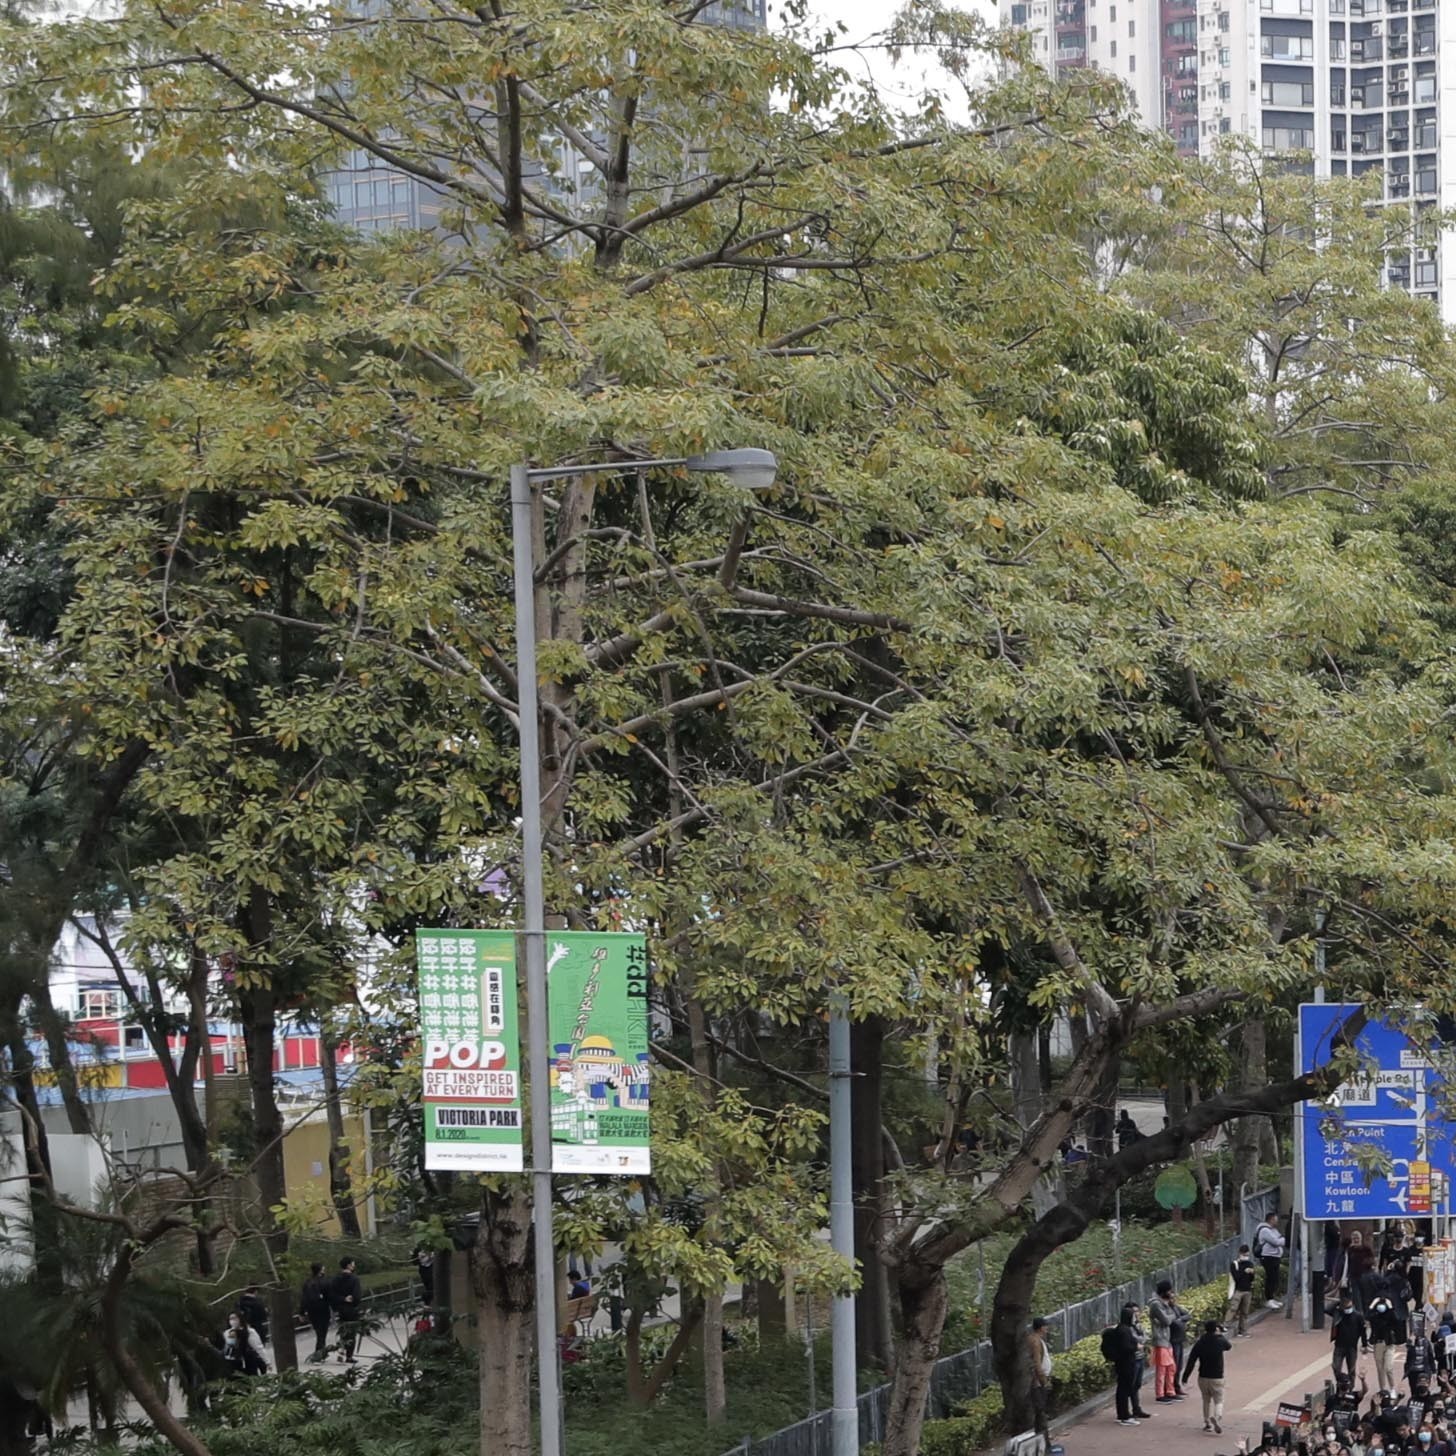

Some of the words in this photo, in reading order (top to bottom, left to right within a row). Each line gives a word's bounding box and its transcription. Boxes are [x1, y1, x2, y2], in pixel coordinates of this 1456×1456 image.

[424, 1041, 506, 1068] POP
[426, 1072, 448, 1084] GET
[453, 1073, 513, 1085] INSPIRED
[426, 1084, 440, 1095] AT
[444, 1085, 479, 1096] EVERY
[483, 1086, 514, 1097] TURN
[438, 1109, 487, 1125] VICTORIA
[489, 1110, 518, 1126] PARK
[1358, 1128, 1385, 1137] Point
[1325, 1171, 1354, 1184] 中區
[1325, 1186, 1370, 1196] Kowloon
[1326, 1200, 1355, 1213] 九龍
